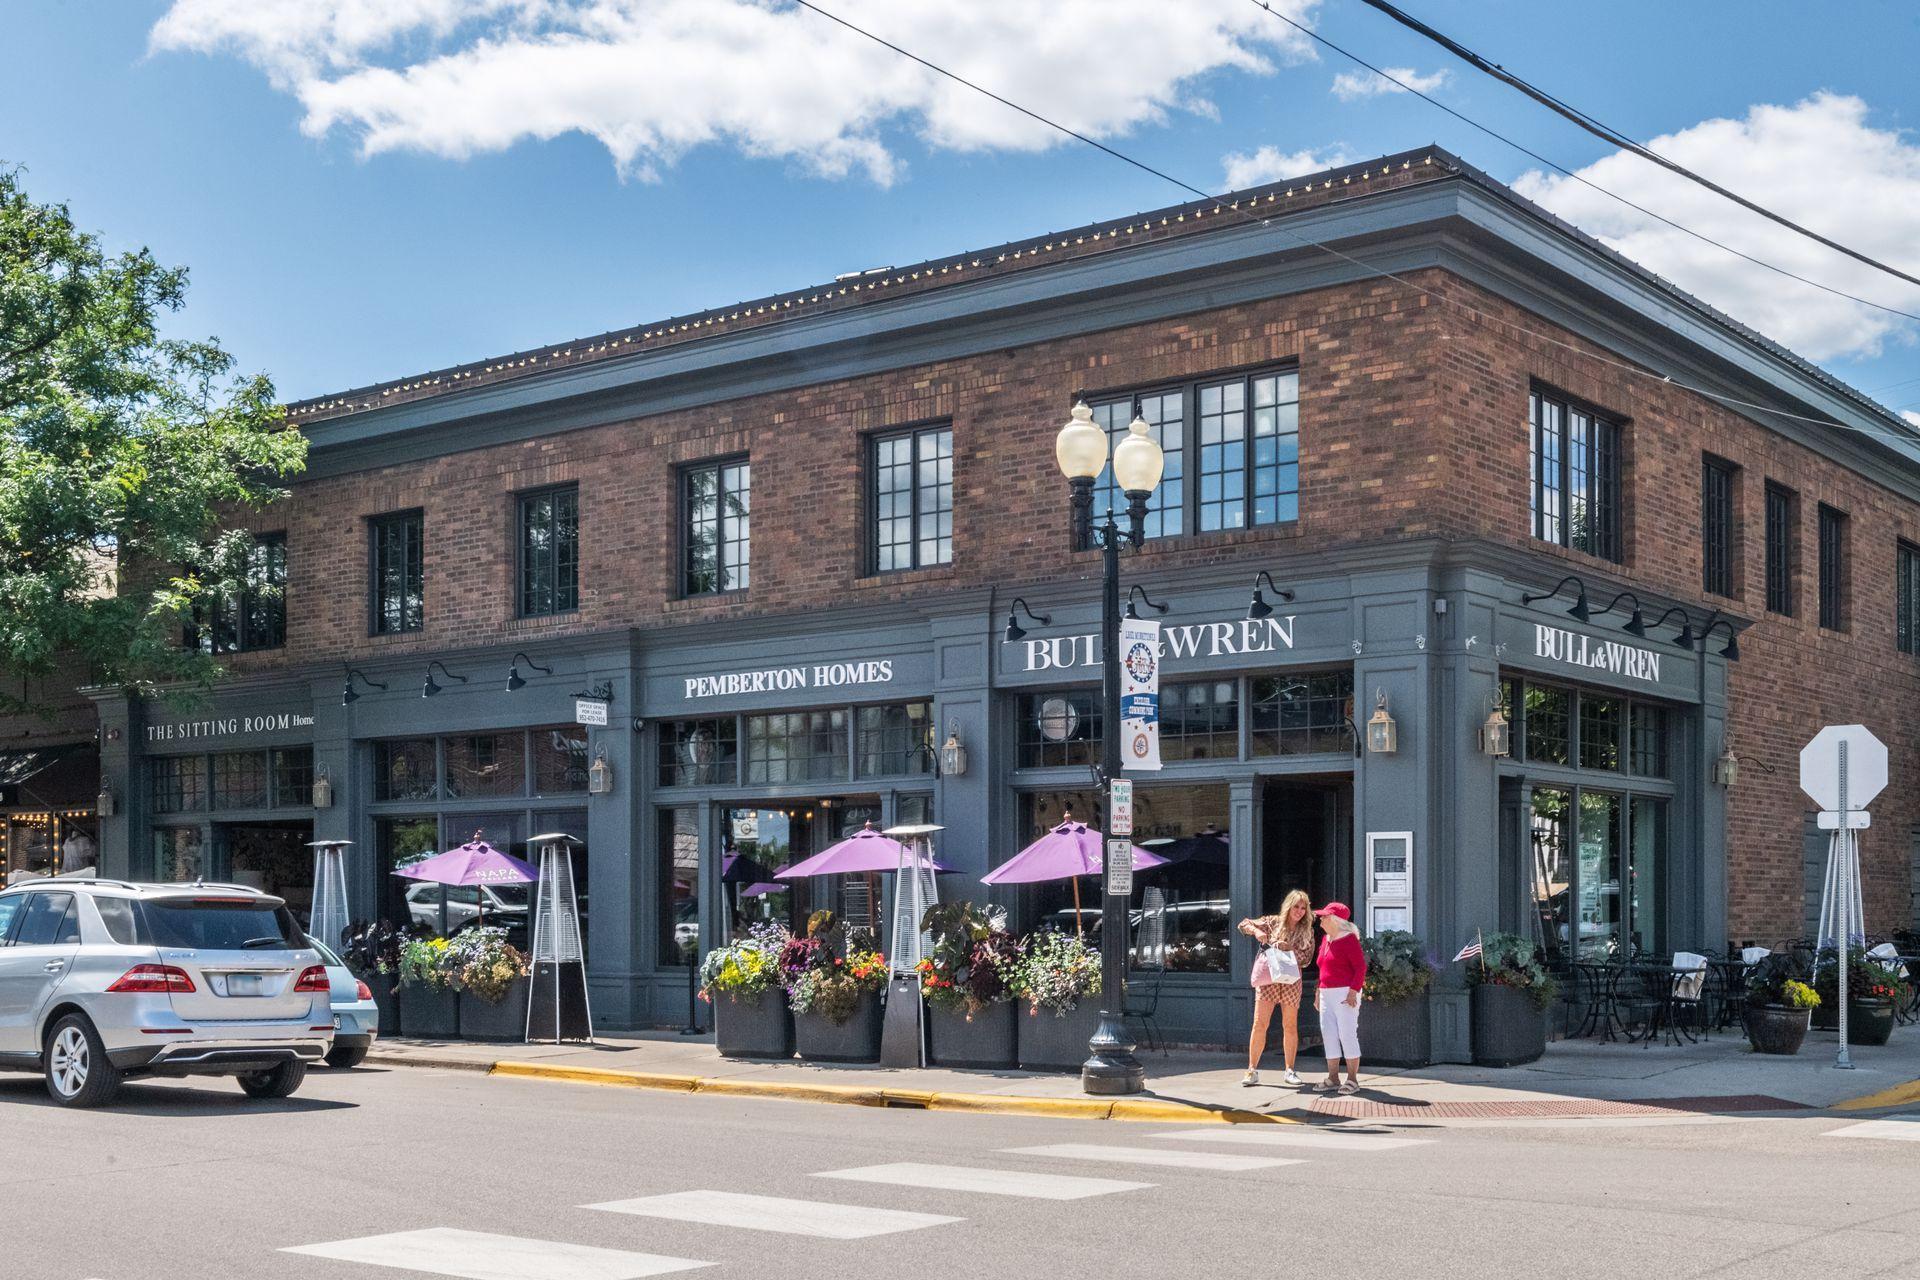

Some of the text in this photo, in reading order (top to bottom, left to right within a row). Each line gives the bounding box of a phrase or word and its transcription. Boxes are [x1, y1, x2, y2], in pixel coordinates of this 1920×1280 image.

[1533, 624, 1660, 683] BULL&WREN
[684, 660, 893, 699] PEMBERTON HOMES
[147, 724, 173, 741] THE
[178, 718, 238, 739] SITTING
[244, 714, 290, 733] ROOM
[1113, 795, 1130, 803] PARKING
[1118, 805, 1126, 814] NO
[1113, 814, 1130, 822] PARKING
[474, 868, 520, 878] NAPA
